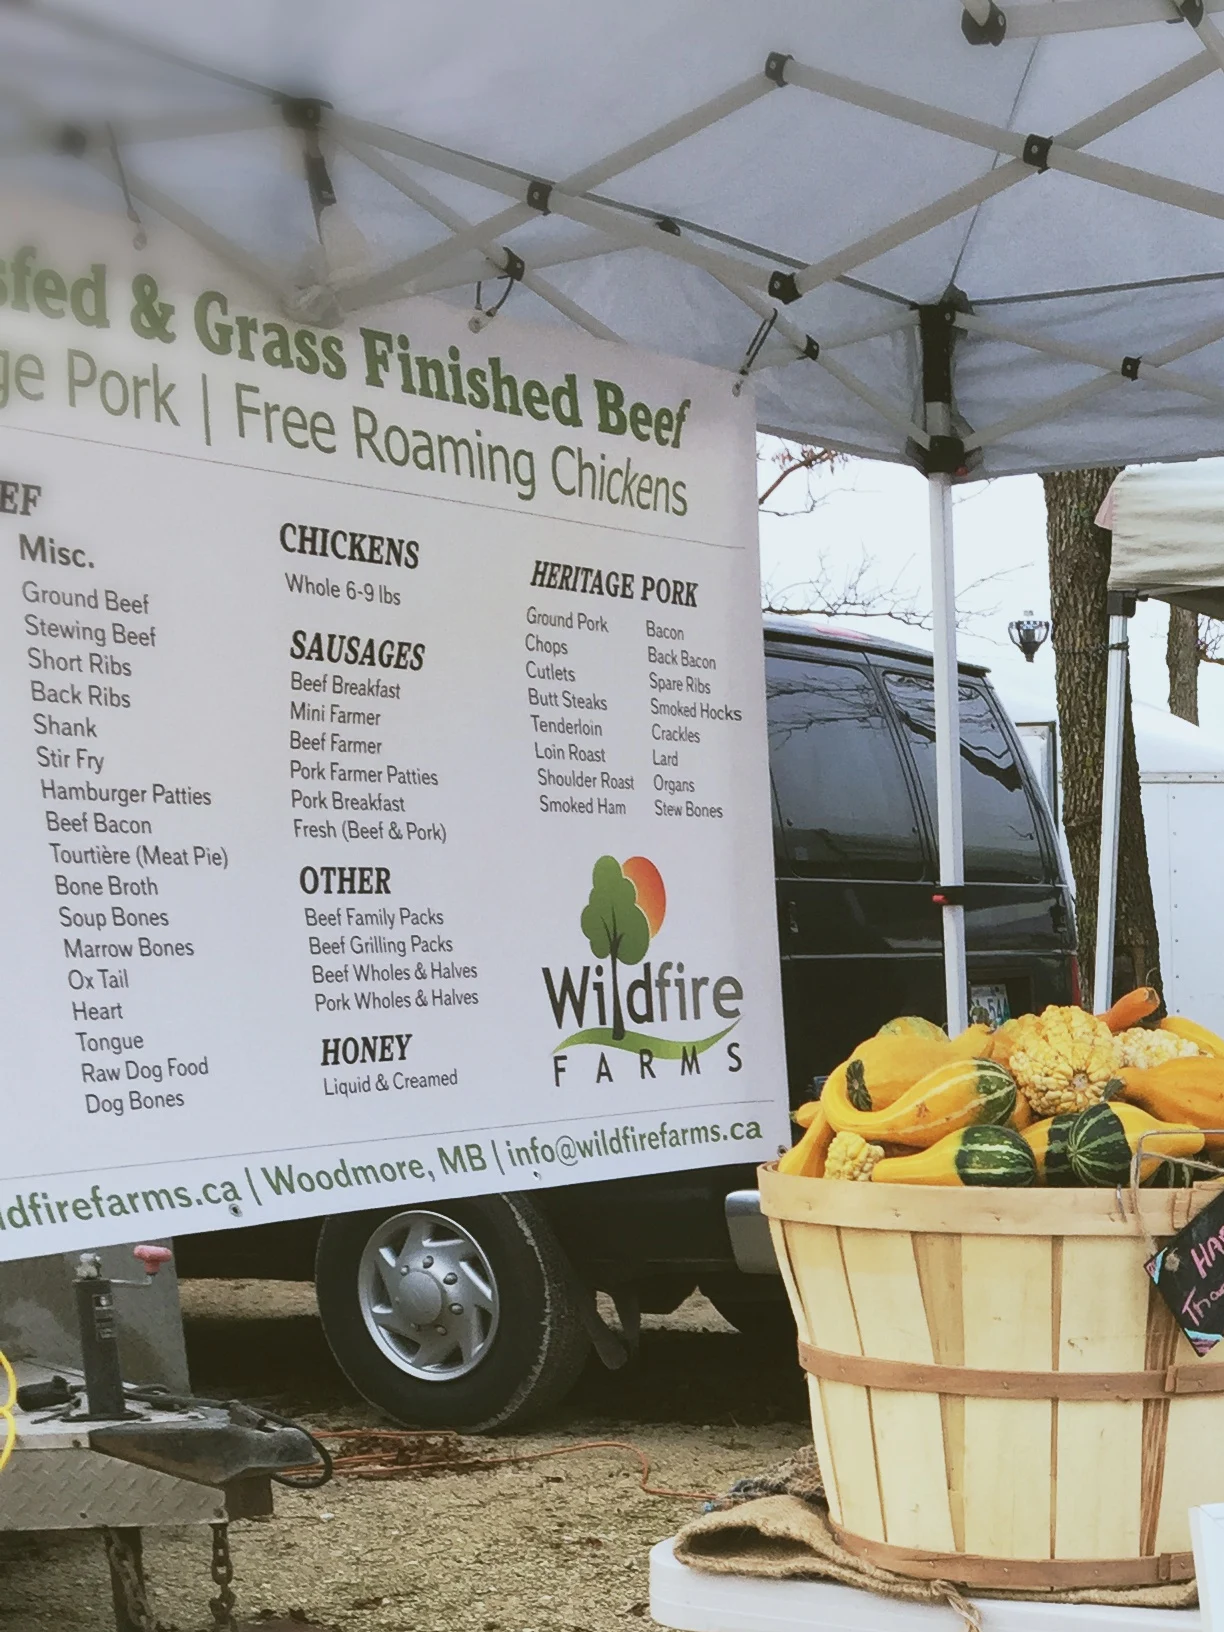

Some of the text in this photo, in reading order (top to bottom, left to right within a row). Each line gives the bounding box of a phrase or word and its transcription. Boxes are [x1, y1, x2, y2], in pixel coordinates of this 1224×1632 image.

[0, 246, 691, 449] fed & Grass Finished Beef
[67, 348, 180, 427] Pork
[235, 383, 336, 453] Free
[353, 405, 535, 500] Roaming
[552, 444, 688, 516] Chickens
[19, 533, 95, 568] Misc.
[280, 522, 420, 569] CHICKENS
[285, 572, 401, 606] Whole 6-9 lbs
[530, 560, 699, 608] HERITAGE PORK
[22, 580, 149, 614] Ground Beef
[24, 614, 156, 648] Stewing Beef
[526, 606, 609, 633] Ground Pork
[646, 620, 684, 641] Bacon
[290, 629, 426, 671] SAUSAGES
[525, 633, 568, 658] Chops
[647, 646, 717, 670] Back Bacon
[27, 647, 132, 677] Short Ribs
[525, 661, 576, 683] Cutlets
[31, 680, 131, 708] Back Ribs
[291, 670, 401, 700] Beef Breakfast
[649, 672, 711, 695] Spare Ribs
[528, 688, 608, 711] Butt Steaks
[650, 698, 742, 721] Smoked Hocks
[33, 713, 98, 738] Shank
[290, 700, 381, 726] Mini Farmer
[530, 715, 603, 737] Tenderloin
[651, 724, 701, 744] Crackles
[290, 730, 382, 754] Beef Farmer
[534, 742, 606, 763] Loin Roast
[36, 745, 104, 774] Stir Fry
[652, 749, 678, 767] Lard
[290, 759, 438, 786] Pork Farmer Patties
[537, 768, 634, 790] Shoulder Roast
[653, 774, 695, 796] Organs
[40, 778, 212, 807] Hamburger Patties
[291, 789, 406, 813] Pork Breakfast
[539, 795, 626, 815] Smoked Ham
[654, 799, 723, 819] Stew Bones
[46, 810, 152, 834] Beef Bacon
[294, 818, 447, 844] Fresh (Beef & Pork)
[48, 842, 229, 869] Tourtière (Meat Pie)
[55, 874, 159, 896] Bone Broth
[300, 865, 391, 895] OTHER
[59, 906, 169, 930] Soup Bones
[305, 906, 444, 930] Beef Family Packs
[64, 937, 195, 958] Marrow Bones
[309, 934, 454, 958] Beef Grilling Packs
[67, 968, 129, 990] Ox Tail
[312, 961, 478, 984] Beef Wholes & Halves
[72, 1001, 123, 1020] Heart
[315, 988, 479, 1012] Pork Wholes & Halves
[76, 1032, 144, 1054] Tongue
[320, 1033, 412, 1066] HONEY
[81, 1056, 209, 1083] Raw Dog Food
[553, 1042, 743, 1087] FARMS
[323, 1067, 458, 1098] Liquid & Creamed
[85, 1090, 185, 1116] Dog Bones
[260, 1159, 436, 1196] Woodmore,
[437, 1144, 487, 1175] MB
[505, 1120, 762, 1166] info@wildfirefarms.ca
